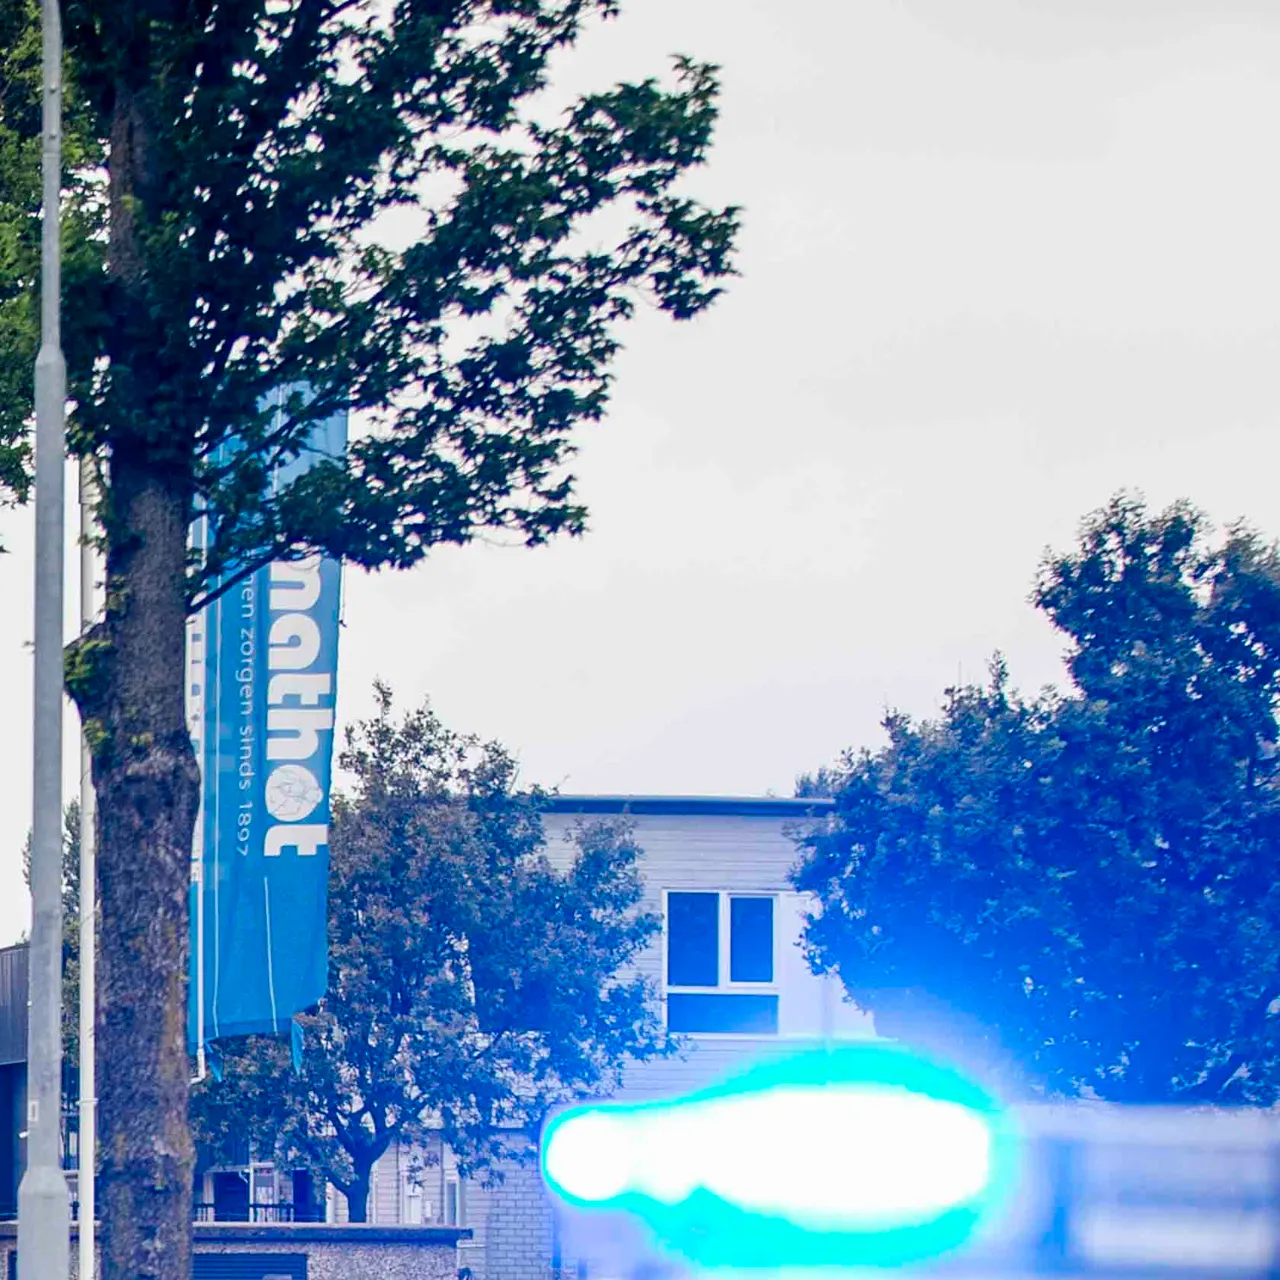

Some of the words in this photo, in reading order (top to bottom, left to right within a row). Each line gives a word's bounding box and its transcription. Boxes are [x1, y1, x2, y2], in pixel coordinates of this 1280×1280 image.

[236, 628, 256, 715] zorgen
[238, 728, 255, 790] sinds
[237, 802, 254, 856] 1897
